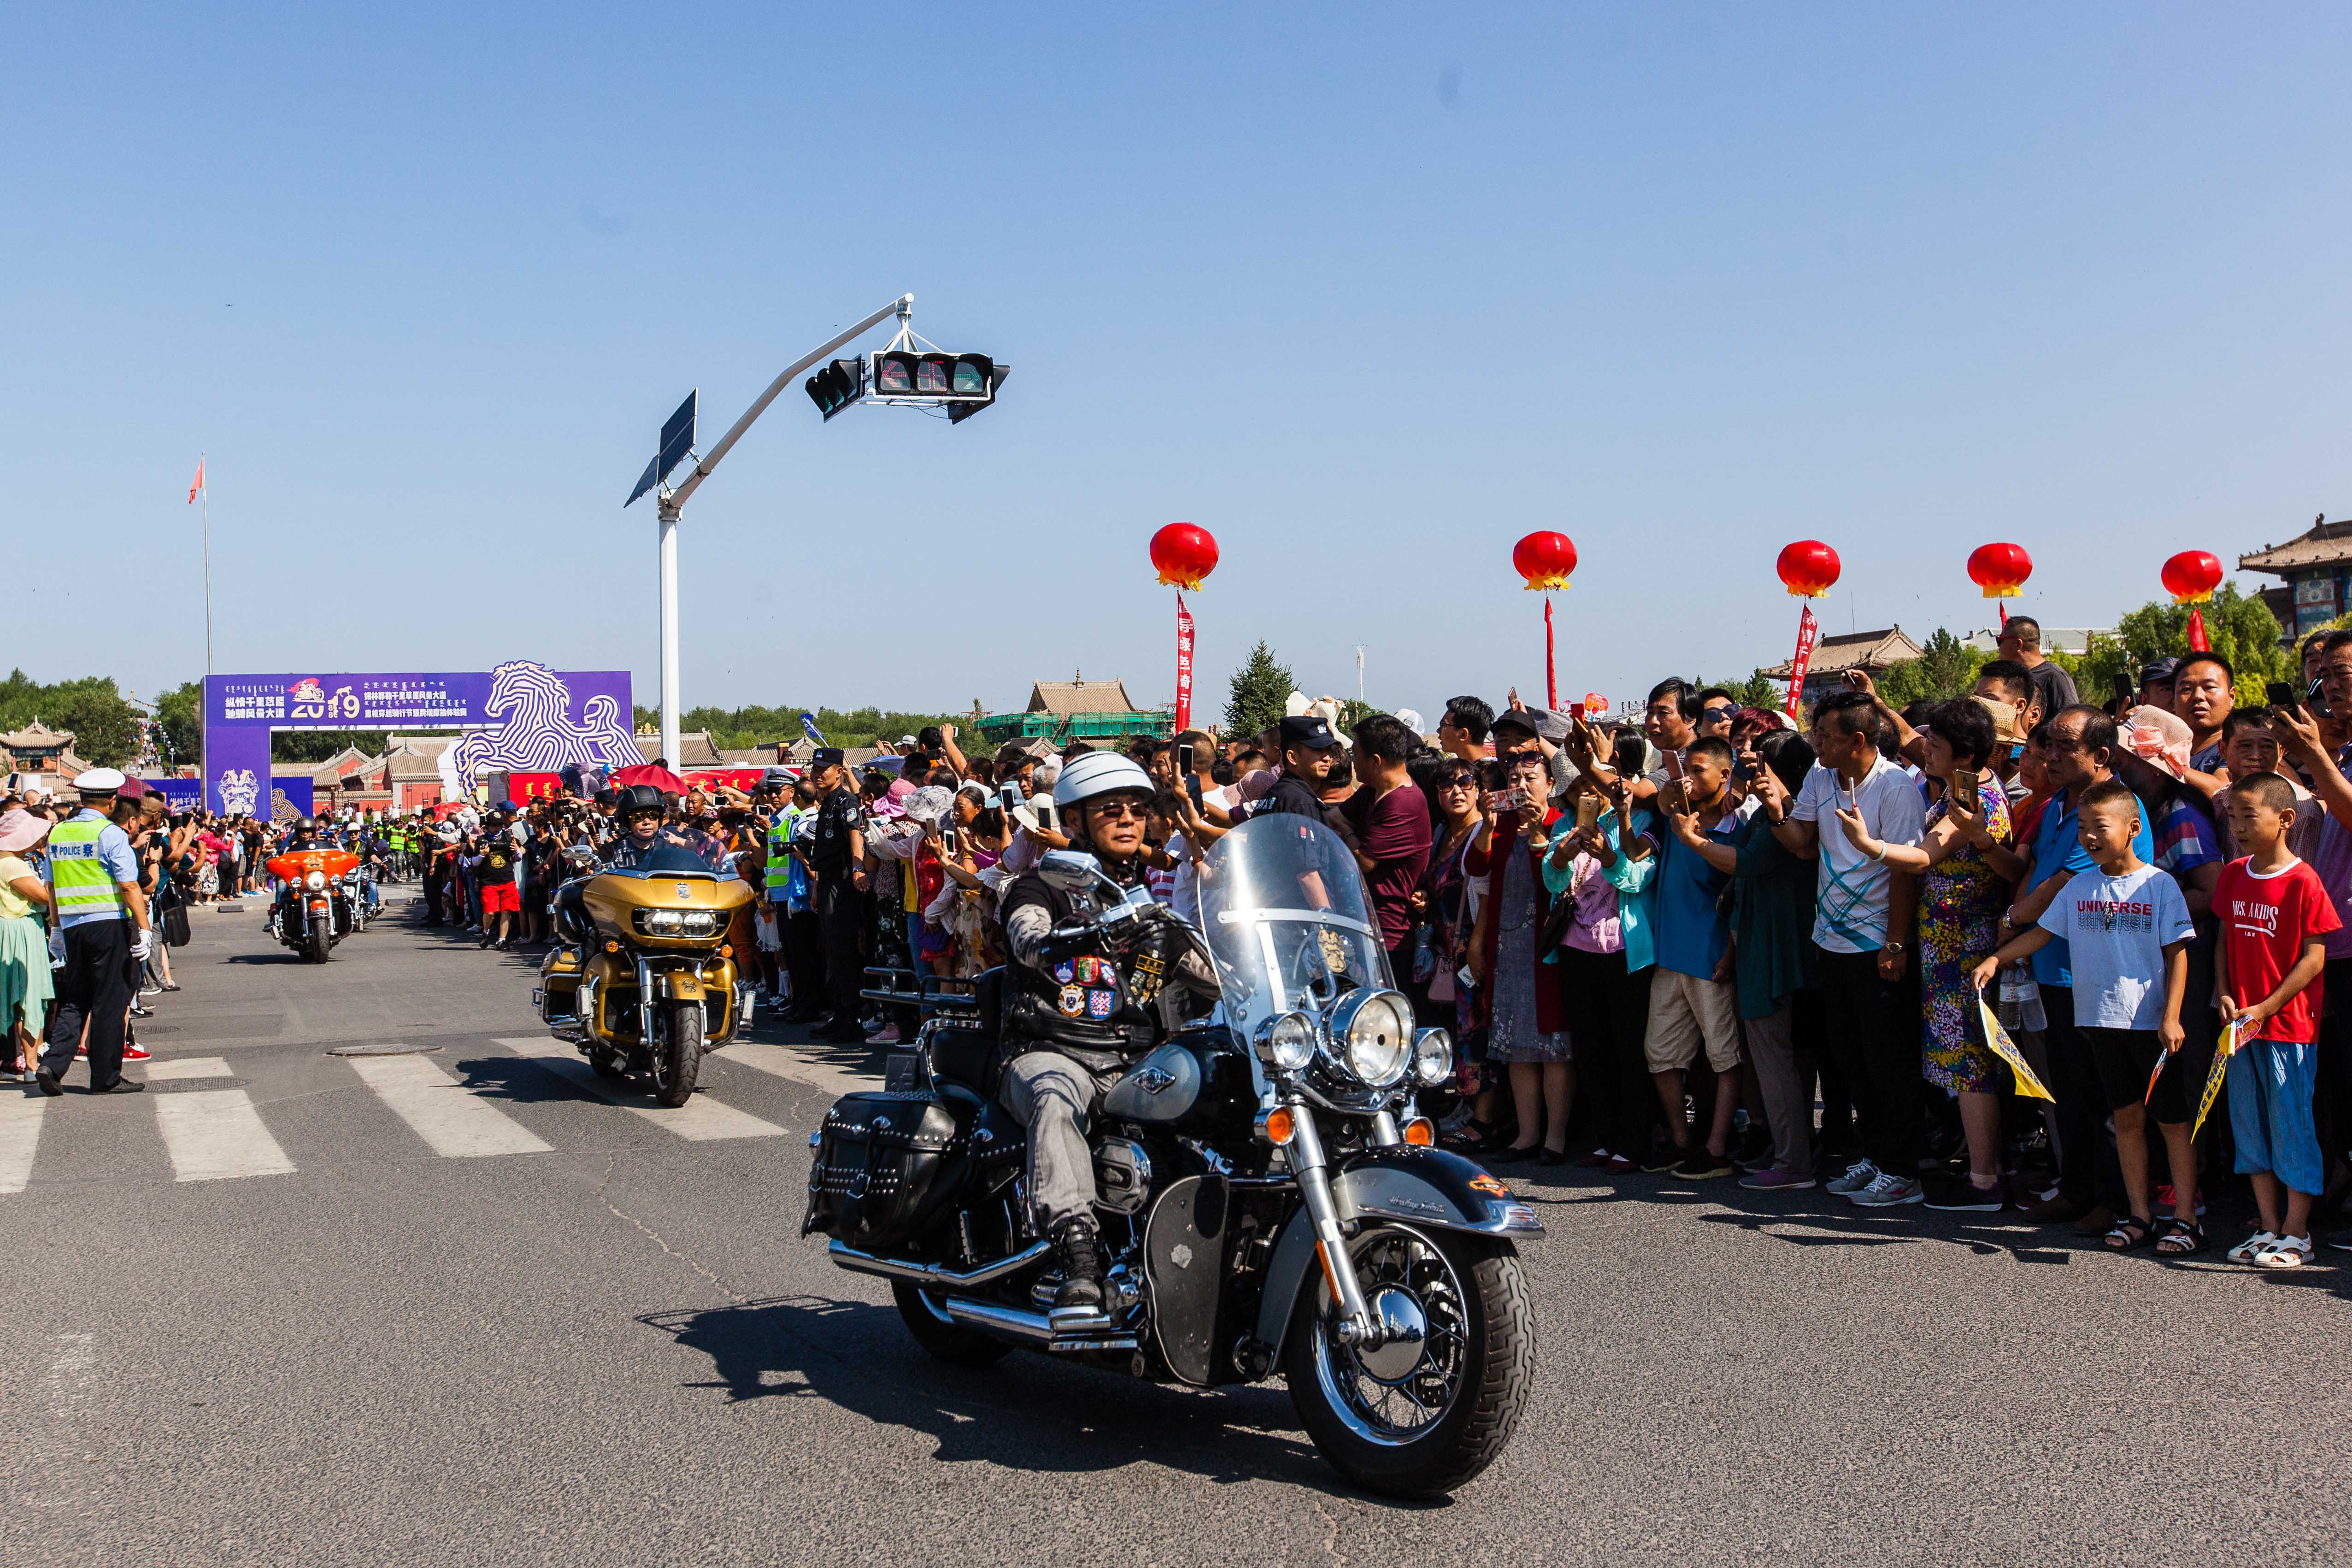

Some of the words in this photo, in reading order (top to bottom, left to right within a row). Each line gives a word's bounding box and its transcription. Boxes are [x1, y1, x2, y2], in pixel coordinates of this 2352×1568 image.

[225, 696, 285, 707] 纵情千里草原
[225, 708, 285, 719] 驰骋风景大道
[50, 844, 58, 858] 警
[59, 846, 81, 856] POLICE
[82, 843, 94, 857] 察
[2077, 900, 2153, 916] UNIVERSE
